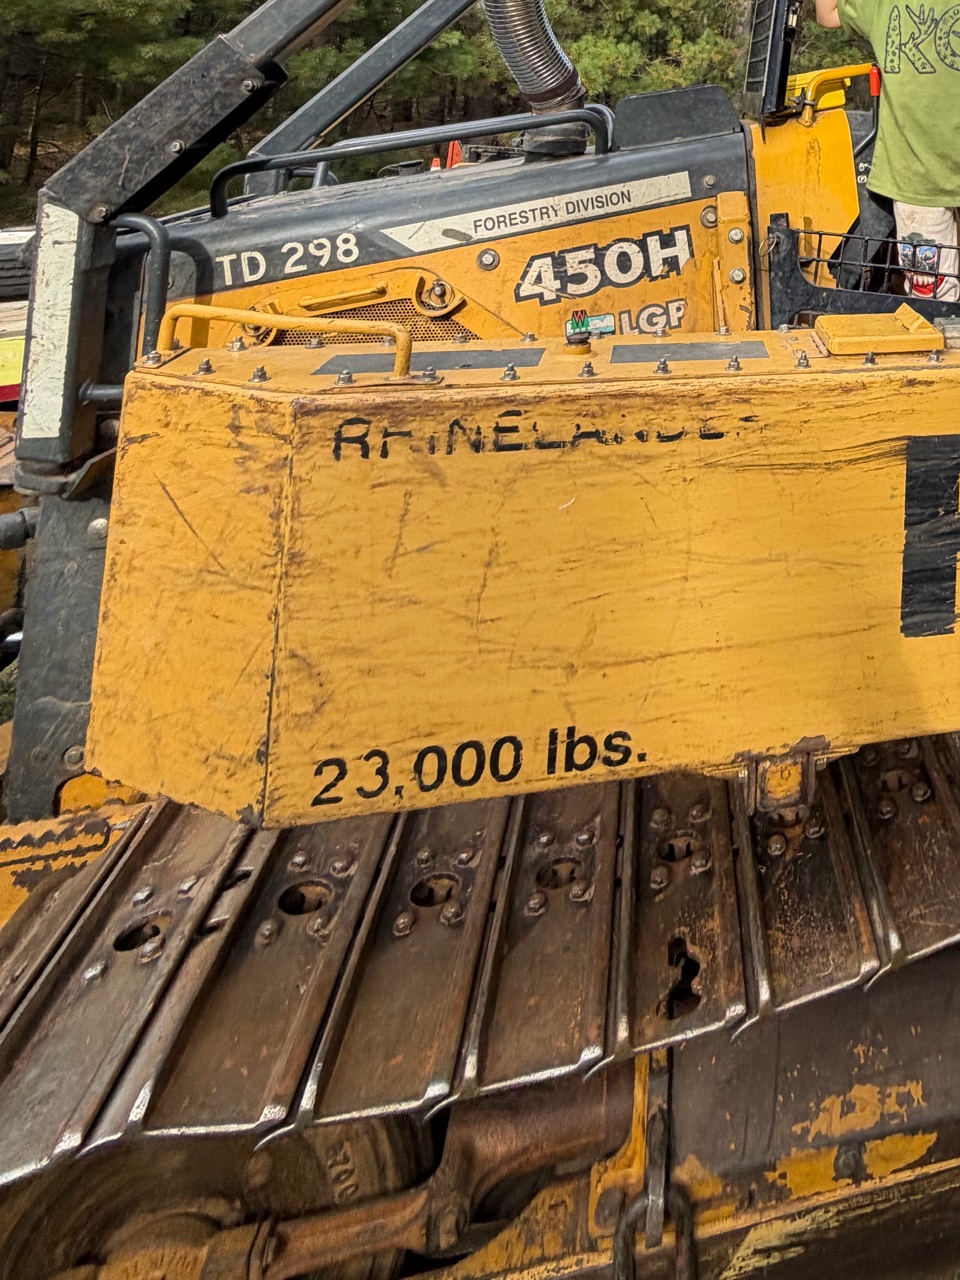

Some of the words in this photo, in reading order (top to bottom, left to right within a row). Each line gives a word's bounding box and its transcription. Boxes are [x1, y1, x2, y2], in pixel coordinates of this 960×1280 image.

[473, 204, 559, 234] FORESTRY
[565, 189, 632, 216] DIVISION
[215, 251, 267, 286] TD
[280, 232, 360, 275] 298
[514, 224, 695, 307] 450H
[619, 298, 688, 336] LGP
[310, 735, 524, 807] 23,000
[546, 726, 647, 775] lbs.
